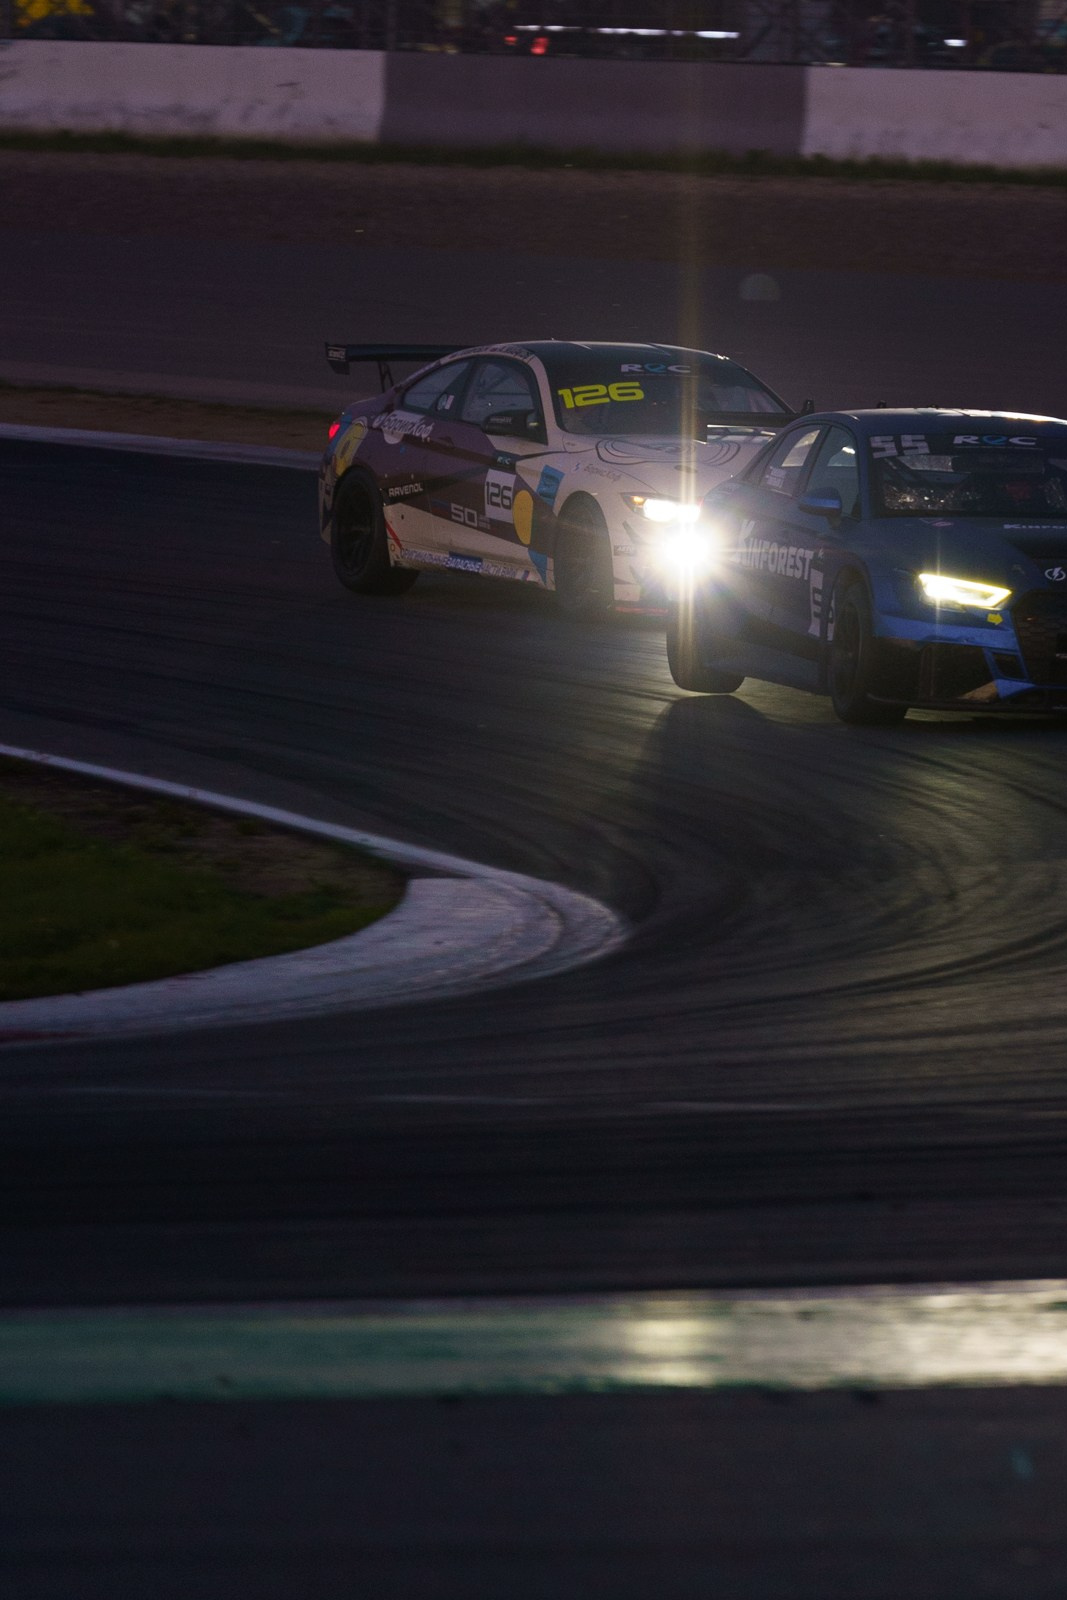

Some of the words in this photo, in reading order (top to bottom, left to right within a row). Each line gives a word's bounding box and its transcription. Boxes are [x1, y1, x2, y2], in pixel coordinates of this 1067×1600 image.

[558, 381, 644, 409] 126
[869, 434, 930, 459] 55
[388, 483, 424, 498] RAVENOL
[485, 482, 512, 510] 126
[451, 503, 478, 528] 50
[734, 519, 814, 581] KINFOREST
